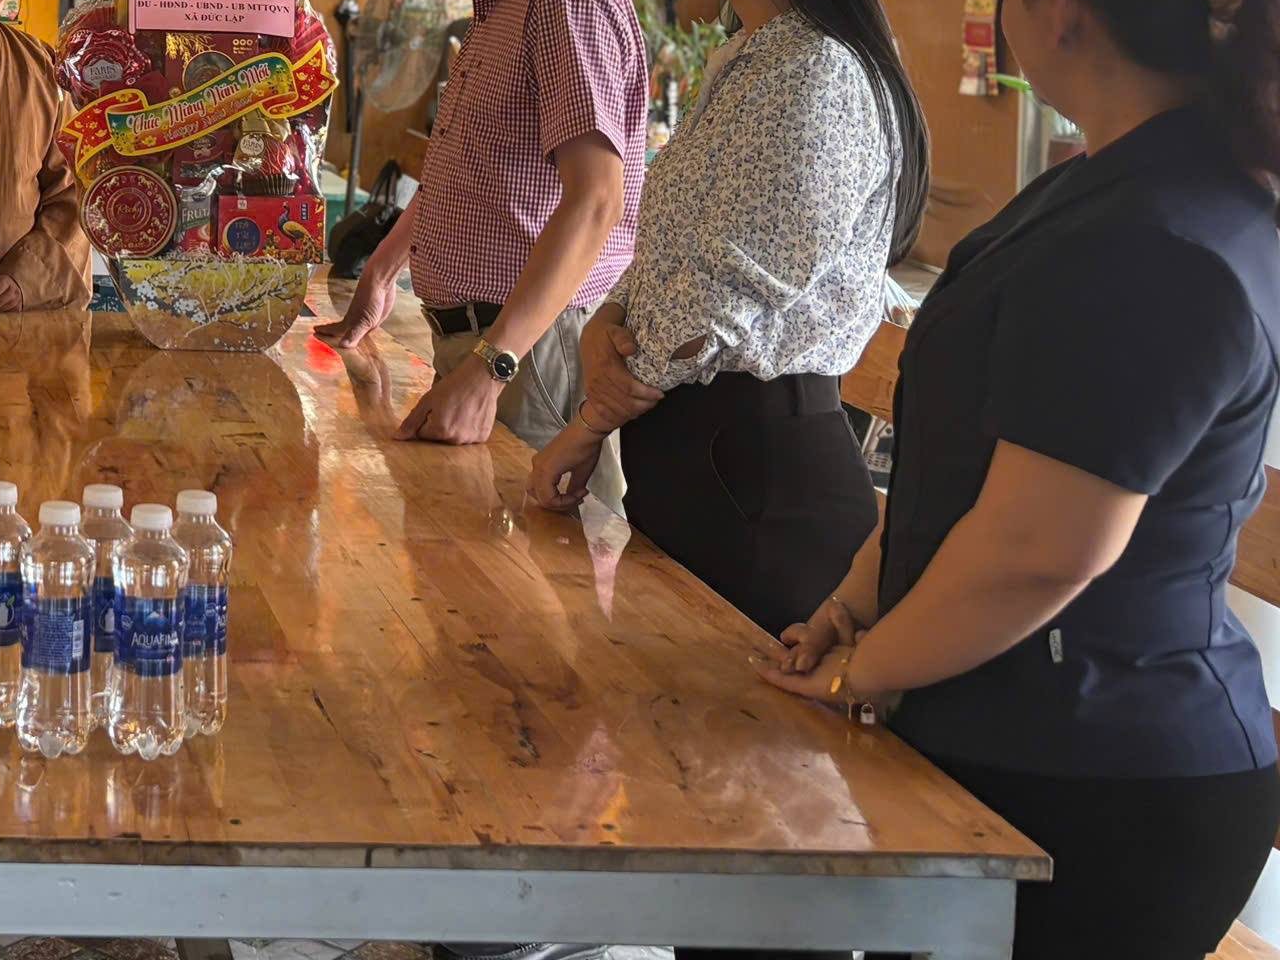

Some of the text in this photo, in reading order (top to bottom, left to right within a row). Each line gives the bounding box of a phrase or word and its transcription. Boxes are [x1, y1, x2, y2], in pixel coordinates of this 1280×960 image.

[196, 2, 223, 10] UBND
[247, 3, 290, 13] MTTQVN
[131, 631, 180, 648] AQUAFINA
